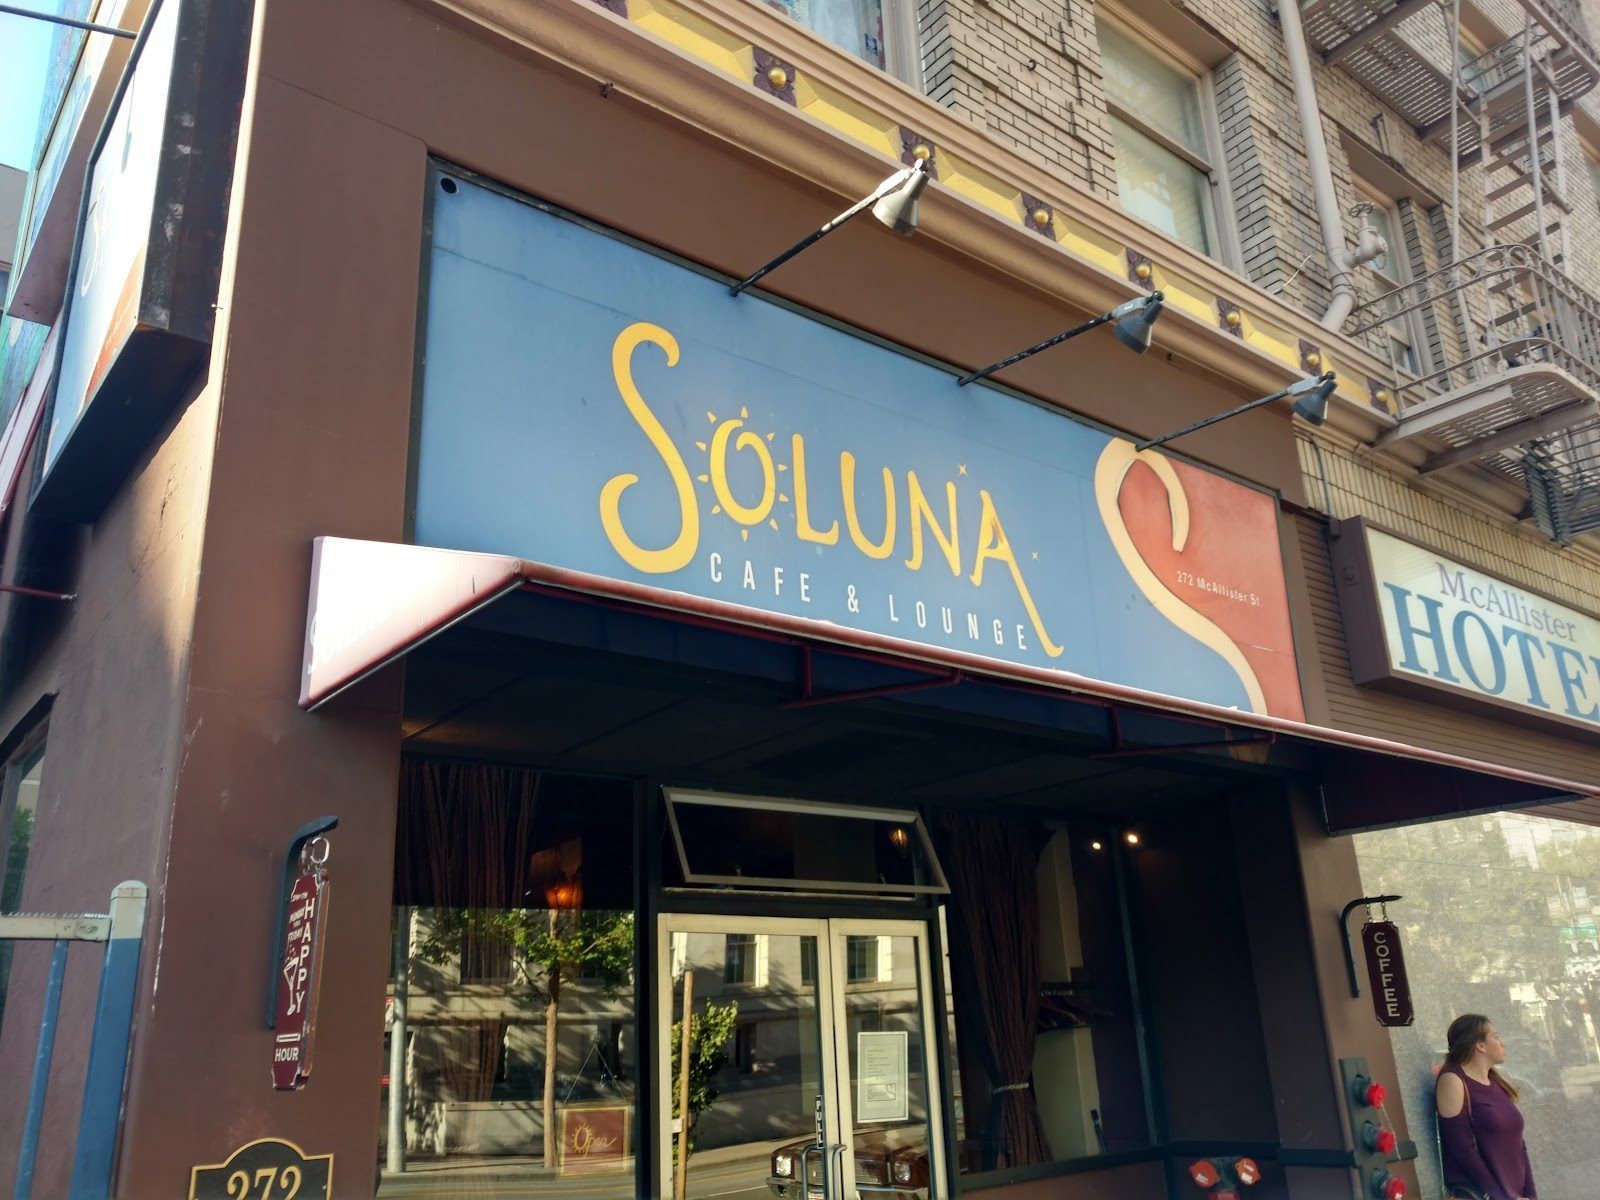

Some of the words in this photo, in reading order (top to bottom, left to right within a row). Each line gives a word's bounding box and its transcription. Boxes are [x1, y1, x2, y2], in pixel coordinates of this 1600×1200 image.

[709, 551, 811, 603] CAFE
[847, 583, 860, 614] &
[888, 593, 1027, 651] LOUNGE
[1176, 570, 1194, 586] 272
[1196, 576, 1248, 602] McAllister
[1435, 561, 1577, 643] McAllister
[1383, 581, 1600, 723] HOTE
[295, 897, 316, 1014] HAPPY
[1373, 931, 1400, 1017] COFFEE
[274, 1047, 300, 1062] HOUR
[572, 1122, 617, 1158] Open
[816, 1100, 824, 1144] PULL
[227, 1166, 302, 1200] 272
